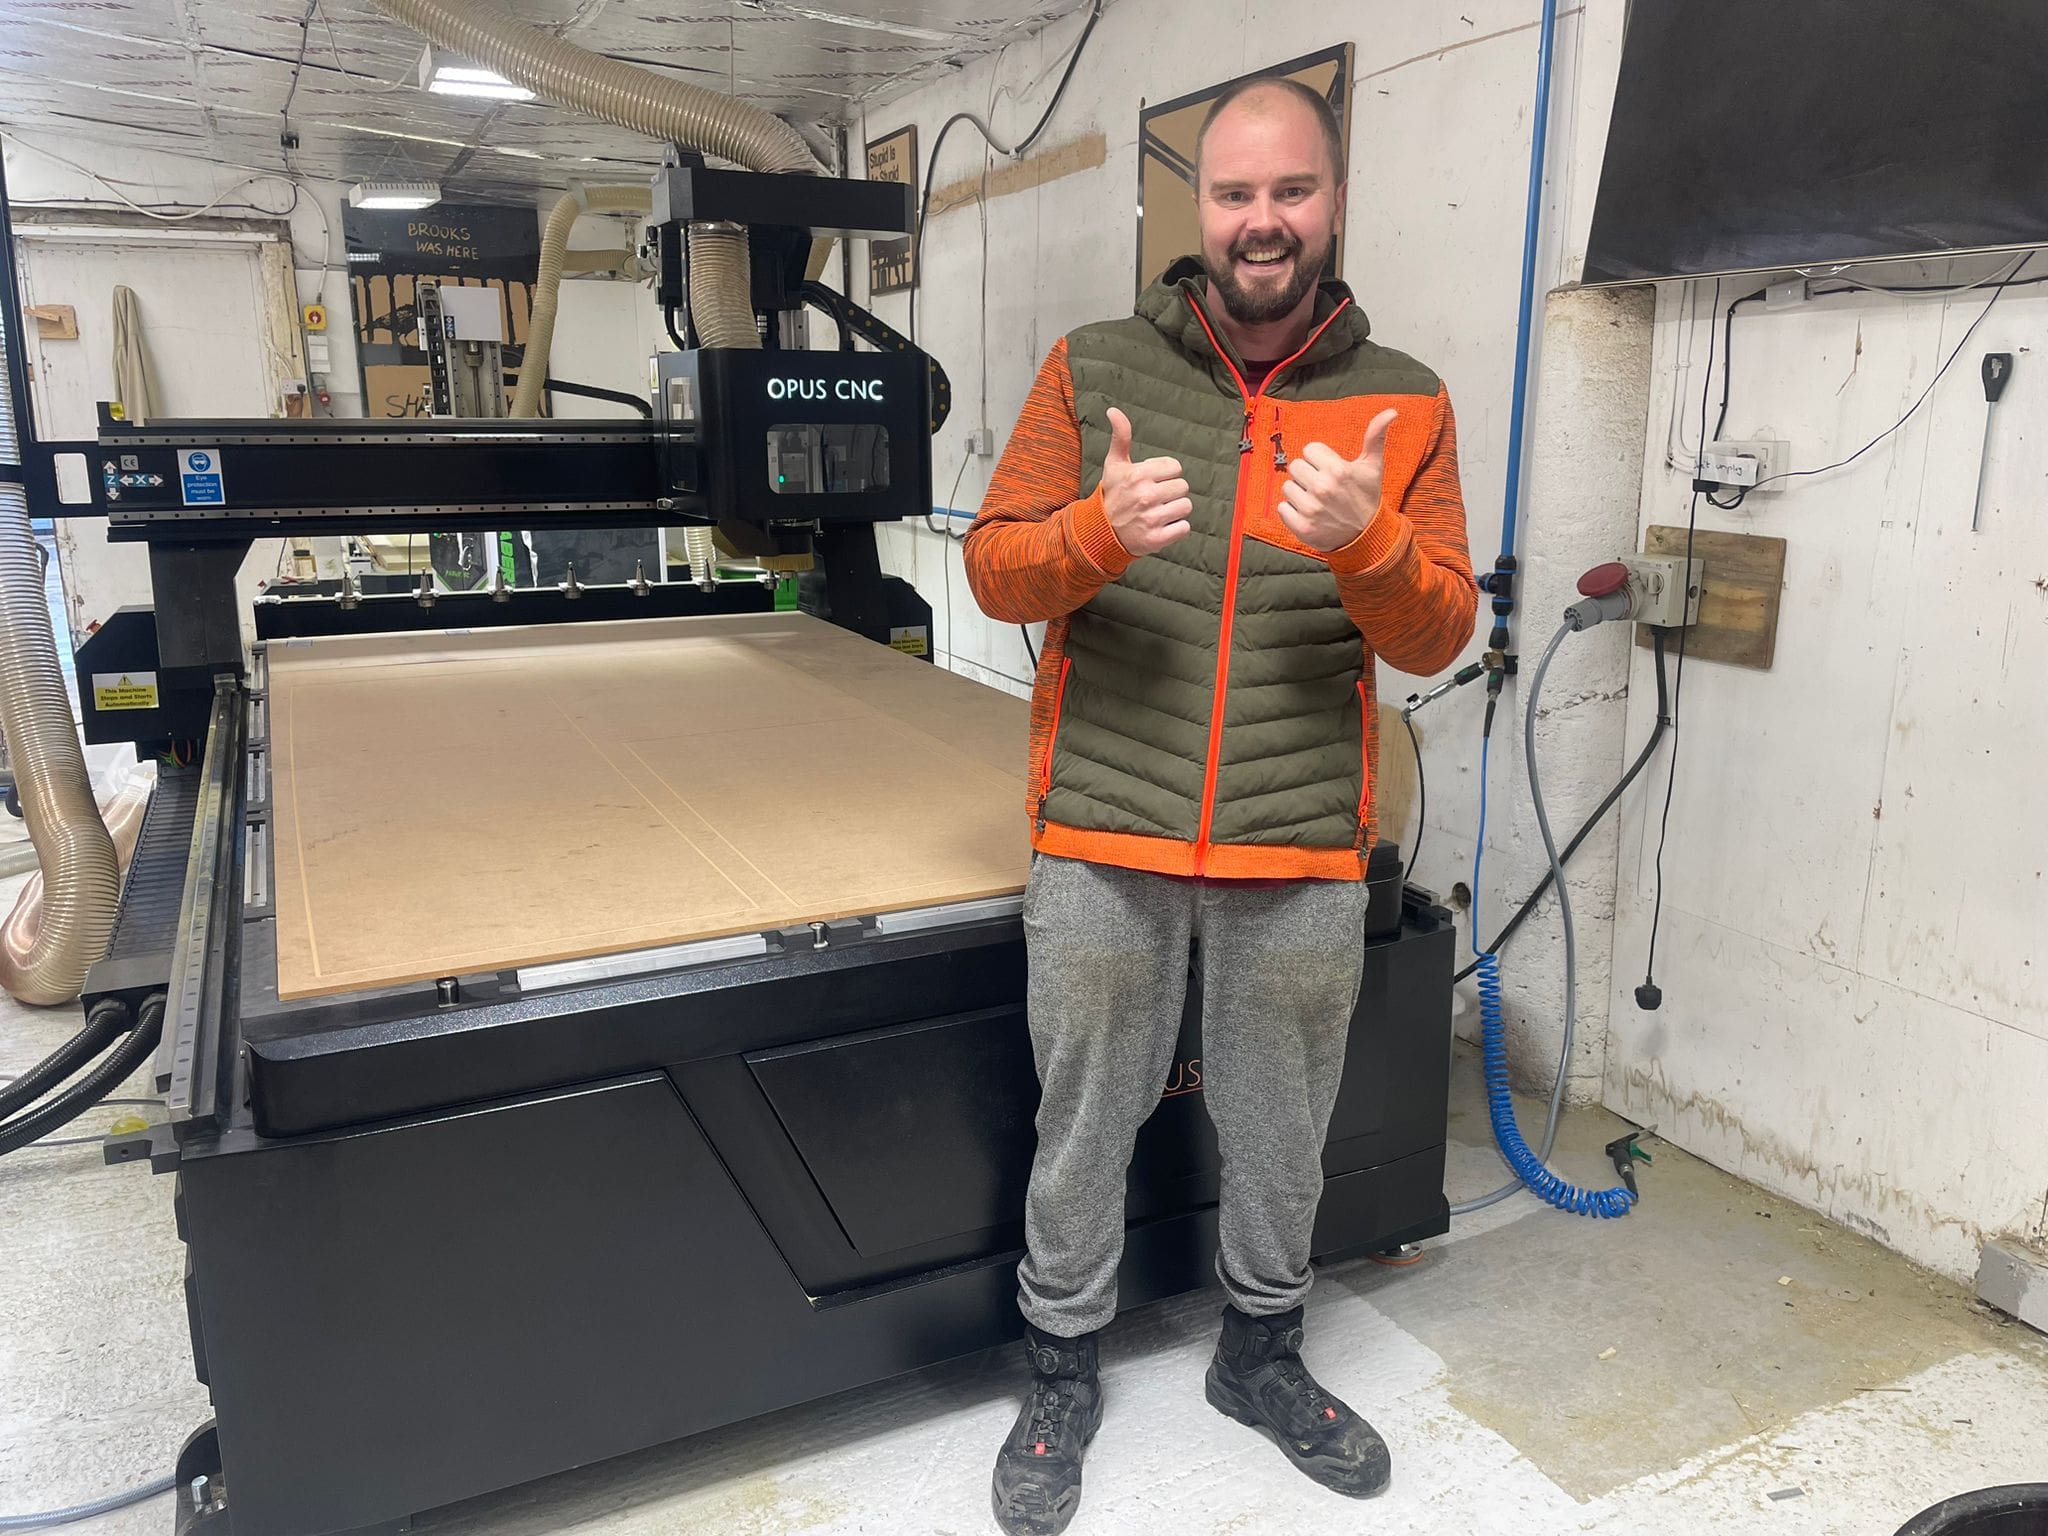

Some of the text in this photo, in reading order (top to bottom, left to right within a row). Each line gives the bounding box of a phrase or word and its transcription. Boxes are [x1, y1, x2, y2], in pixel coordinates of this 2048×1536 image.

[680, 15, 795, 23] EcoTherm
[869, 144, 896, 170] Stupid Is
[407, 222, 471, 241] BROOKS
[416, 241, 480, 260] WAS HERE
[767, 377, 884, 401] OPUS CNC
[107, 475, 116, 485] Z
[135, 474, 147, 485] X
[1161, 1059, 1201, 1091] US
